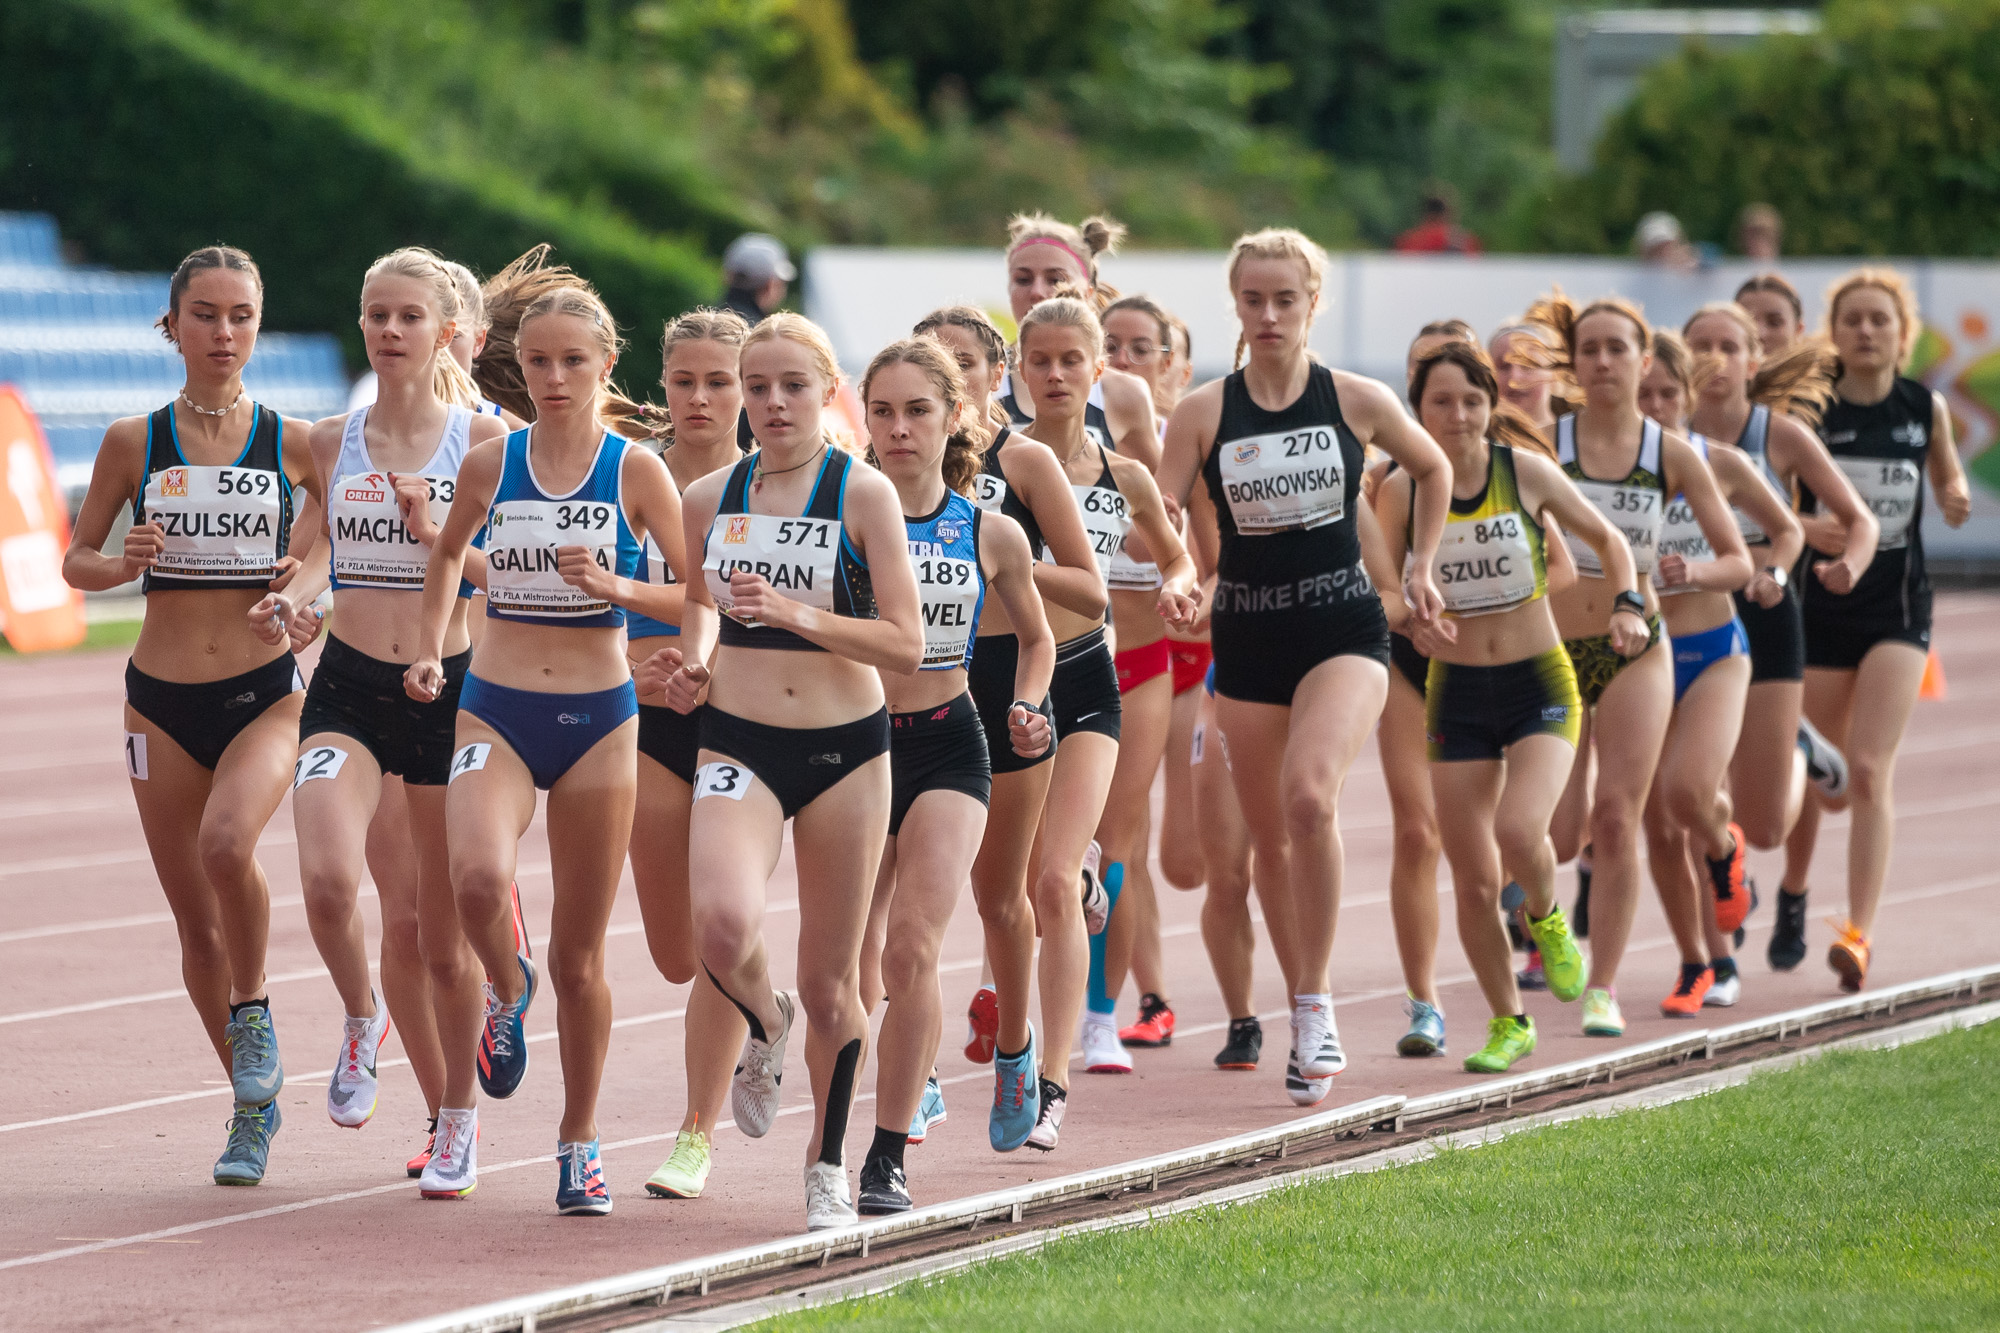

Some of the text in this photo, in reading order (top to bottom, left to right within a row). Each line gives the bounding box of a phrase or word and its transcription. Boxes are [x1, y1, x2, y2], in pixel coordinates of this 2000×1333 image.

[1283, 431, 1331, 457] 270
[217, 471, 270, 495] 569
[1229, 466, 1341, 504] BORKOWSKA
[347, 490, 382, 501] ORLEN
[1084, 491, 1125, 519] 638
[1611, 491, 1654, 514] 357
[151, 512, 271, 538] SZULSKA
[556, 506, 610, 530] 349
[776, 522, 829, 549] 571
[937, 528, 960, 538] ASTRA
[1475, 519, 1518, 544] 843
[165, 556, 182, 564] PZLA
[184, 557, 232, 566] Mistrzostwa
[234, 558, 257, 566] Polski
[259, 557, 274, 566] U18
[336, 561, 346, 570] 54.
[348, 563, 365, 571] PZLA
[367, 564, 413, 573] Mistrzostwa
[920, 561, 970, 585] 189
[1440, 556, 1512, 584] SZULC
[490, 591, 501, 599] 54.
[503, 592, 520, 600] PZLA
[523, 593, 569, 602] Mistrzostwa
[1234, 583, 1292, 613] NIKE
[1298, 569, 1349, 604] PRO
[922, 603, 966, 626] WEL
[930, 643, 966, 654] Polski U18
[931, 707, 950, 720] 4F
[126, 736, 138, 775] 1
[305, 749, 336, 779] 2
[454, 745, 477, 773] 4
[709, 766, 740, 792] 3
